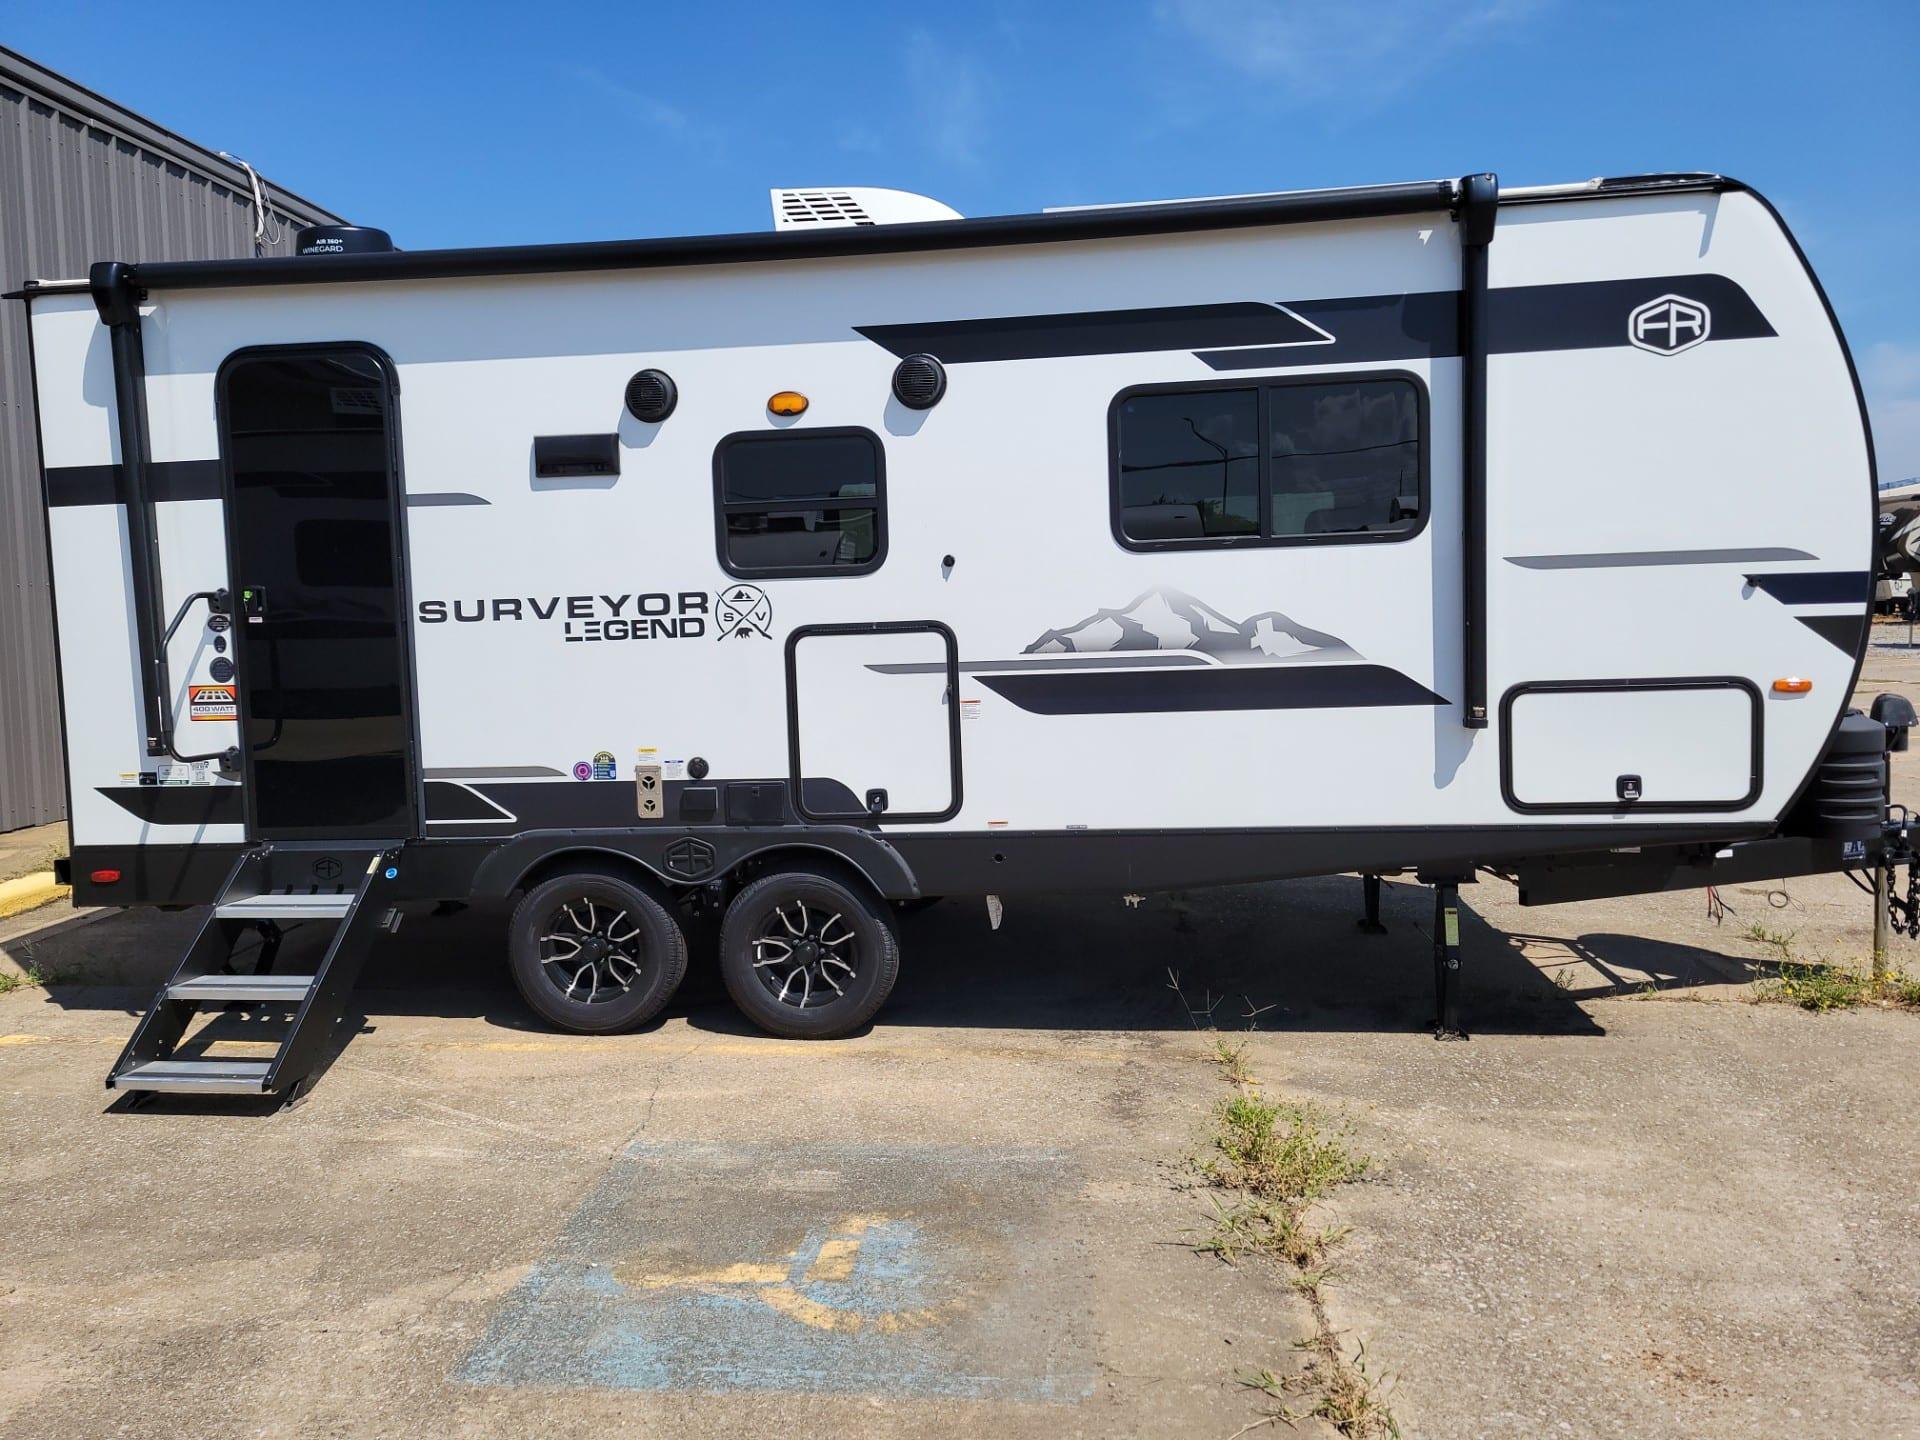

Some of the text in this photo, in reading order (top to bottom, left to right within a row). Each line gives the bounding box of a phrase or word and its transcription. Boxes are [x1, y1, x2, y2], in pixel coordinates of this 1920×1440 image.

[302, 245, 344, 254] WINEGARD
[419, 591, 709, 624] SURVEYOR
[723, 611, 767, 623] S V
[565, 617, 706, 643] LEGEND
